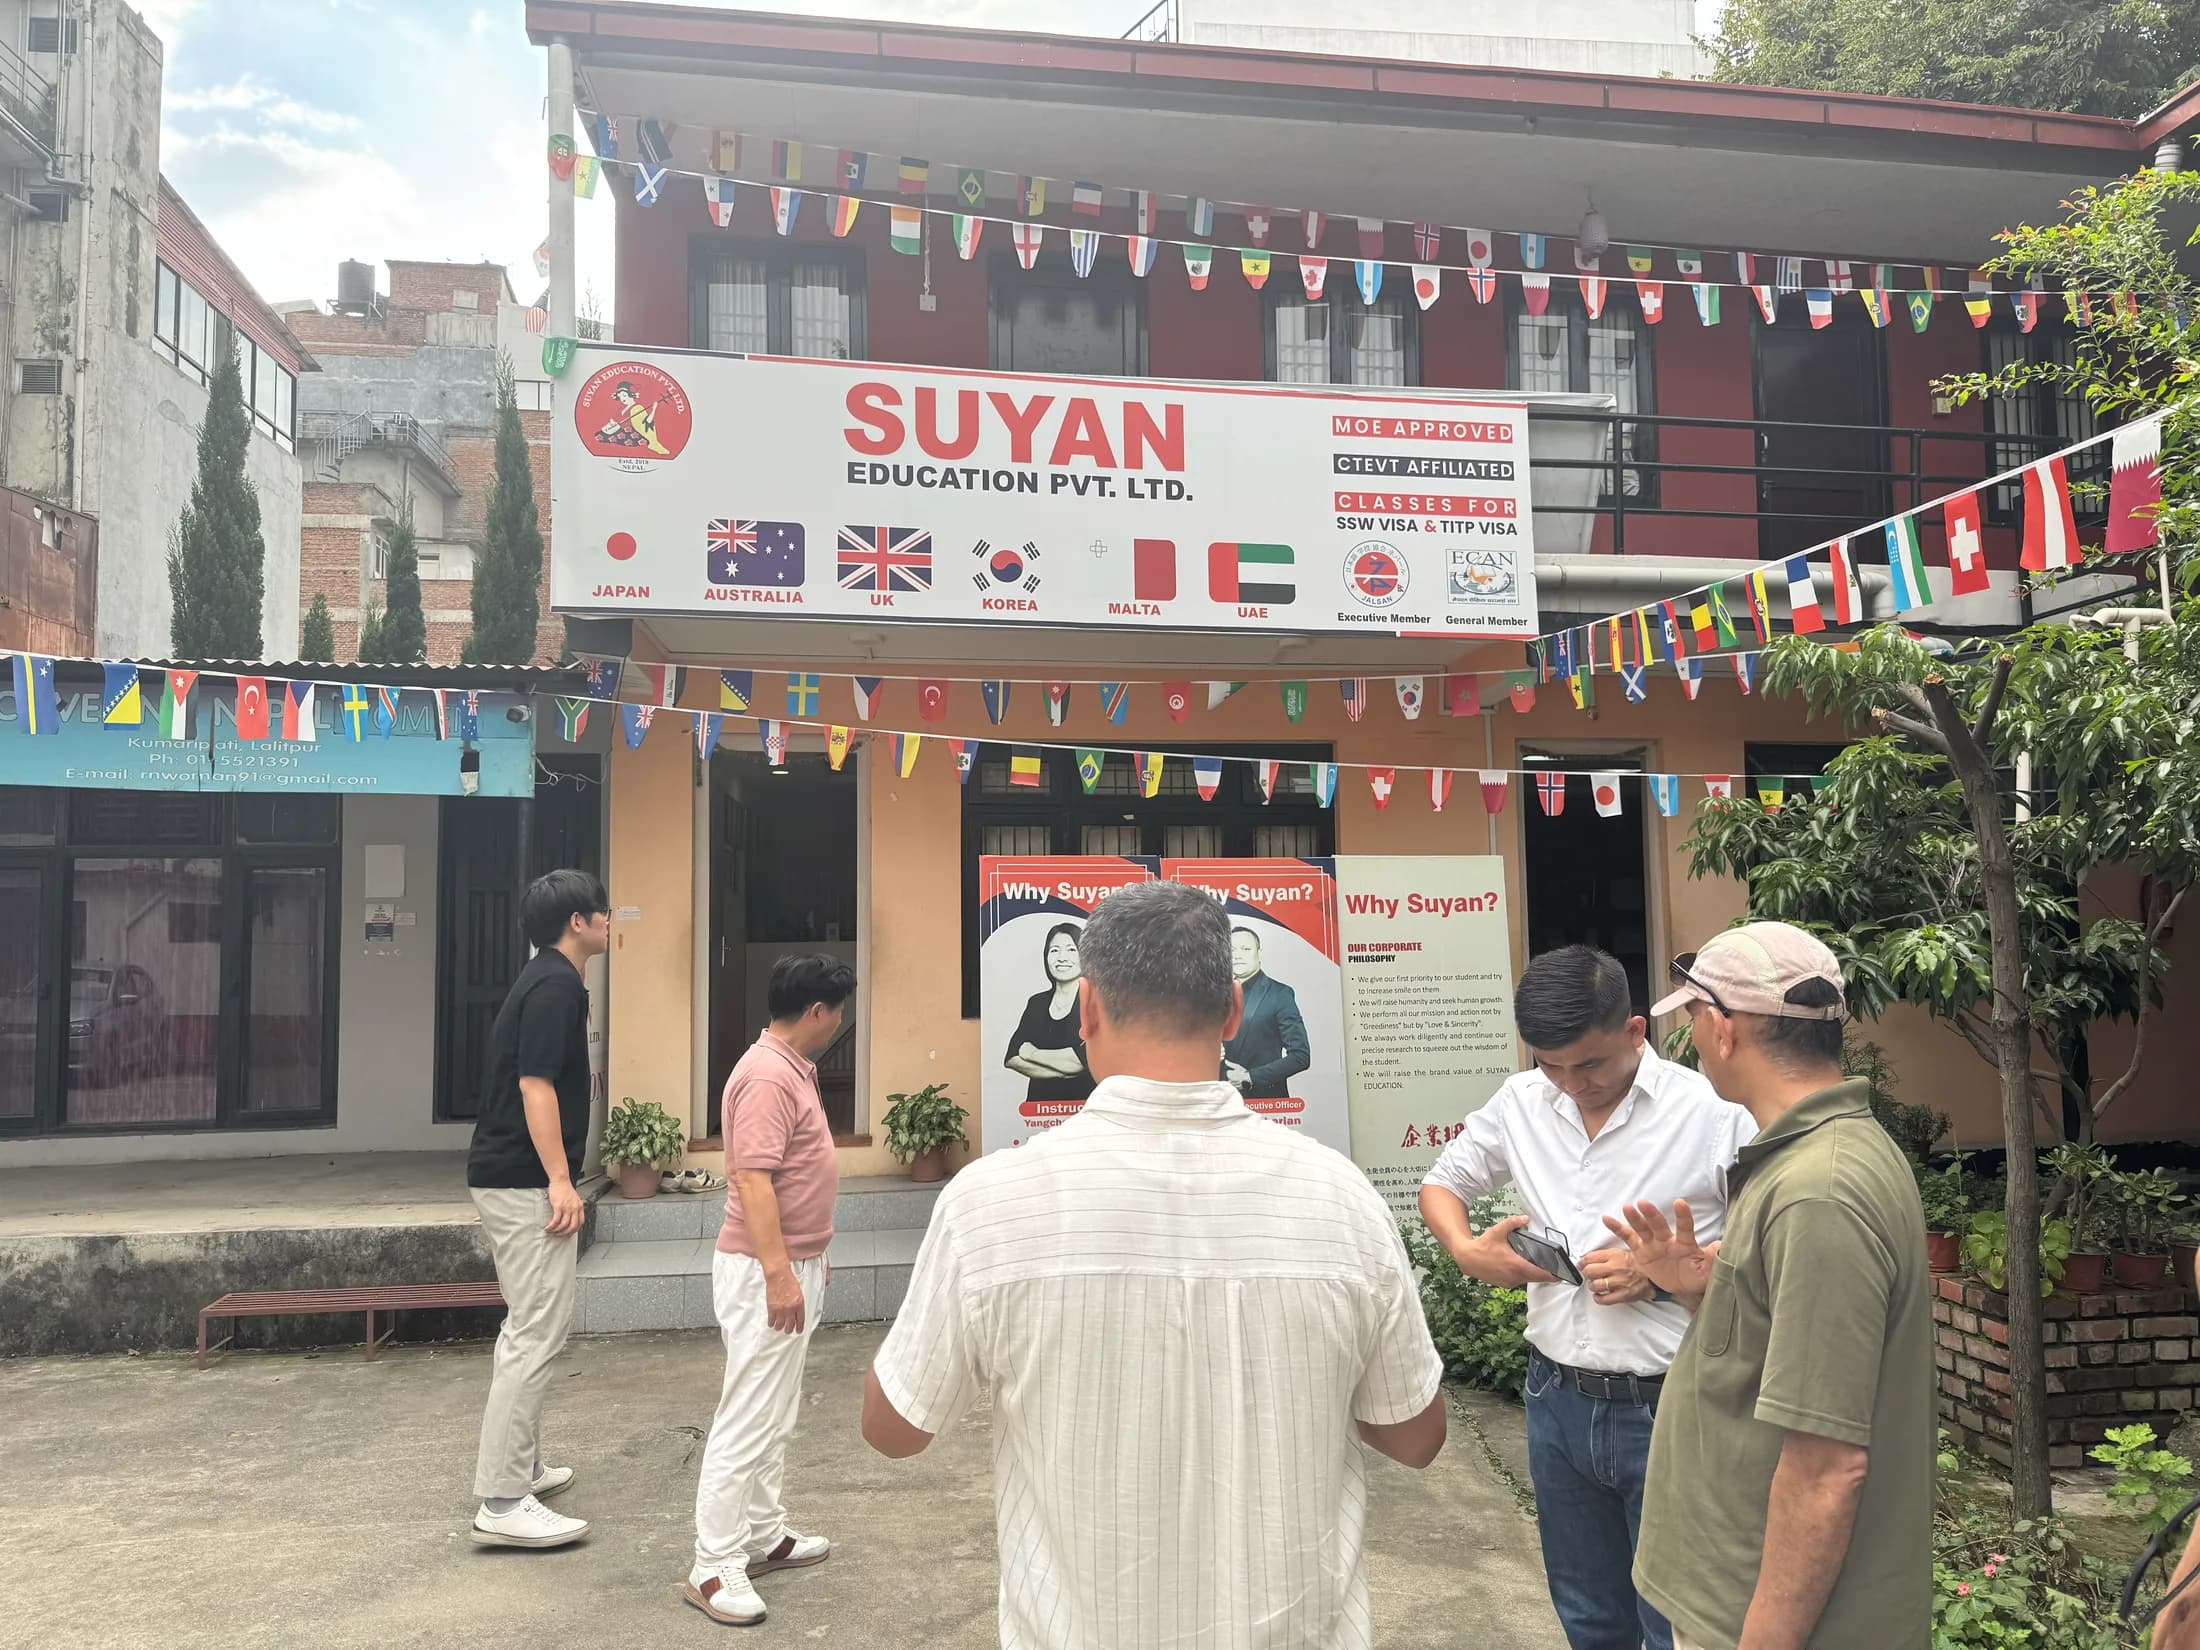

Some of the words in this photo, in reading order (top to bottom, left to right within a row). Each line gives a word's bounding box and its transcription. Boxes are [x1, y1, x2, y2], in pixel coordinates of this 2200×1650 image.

[583, 378, 603, 408] SUYAN
[603, 366, 658, 382] EDUCATION
[844, 382, 1185, 472] SUYAN
[1335, 418, 1382, 435] MOE
[1394, 421, 1512, 441] APPROVED
[1337, 457, 1400, 473] CTEVT
[1407, 460, 1512, 478] AFFILIATED
[847, 461, 1038, 494] EDUCATION
[1050, 473, 1116, 498] PVT.
[1128, 477, 1194, 501] LTD.
[1338, 494, 1452, 512] CLASSES
[1468, 499, 1515, 515] FOR
[1336, 516, 1374, 531] SSW
[1379, 518, 1418, 532] VISA
[1424, 519, 1437, 533] &
[1440, 520, 1475, 534] TITP
[1478, 521, 1518, 536] VISA
[1452, 551, 1513, 566] ECAN
[592, 585, 650, 599] JAPAN
[704, 588, 804, 604] AUSTRALIA
[870, 594, 894, 607] UK
[982, 598, 1039, 612] KOREA
[1108, 602, 1161, 616] MALTA
[1237, 607, 1268, 619] UAE
[1337, 612, 1387, 624] Executive
[1390, 613, 1431, 624] Member
[1445, 615, 1485, 626] General
[1487, 616, 1528, 627] Member
[251, 740, 322, 755] Lalitpur
[1003, 882, 1051, 905] Why
[1191, 885, 1229, 905] hy
[1236, 883, 1313, 905] Suyan?
[1345, 894, 1399, 919] Why
[1407, 892, 1498, 918] Suyan?
[1347, 943, 1367, 953] OUR
[1368, 942, 1422, 952] CORPORATE
[1348, 954, 1396, 963] PHILOSOPHY
[1370, 976, 1383, 984] give
[1372, 1010, 1398, 1018] perform
[1418, 1033, 1447, 1041] diligently
[1276, 1101, 1302, 1110] Officer
